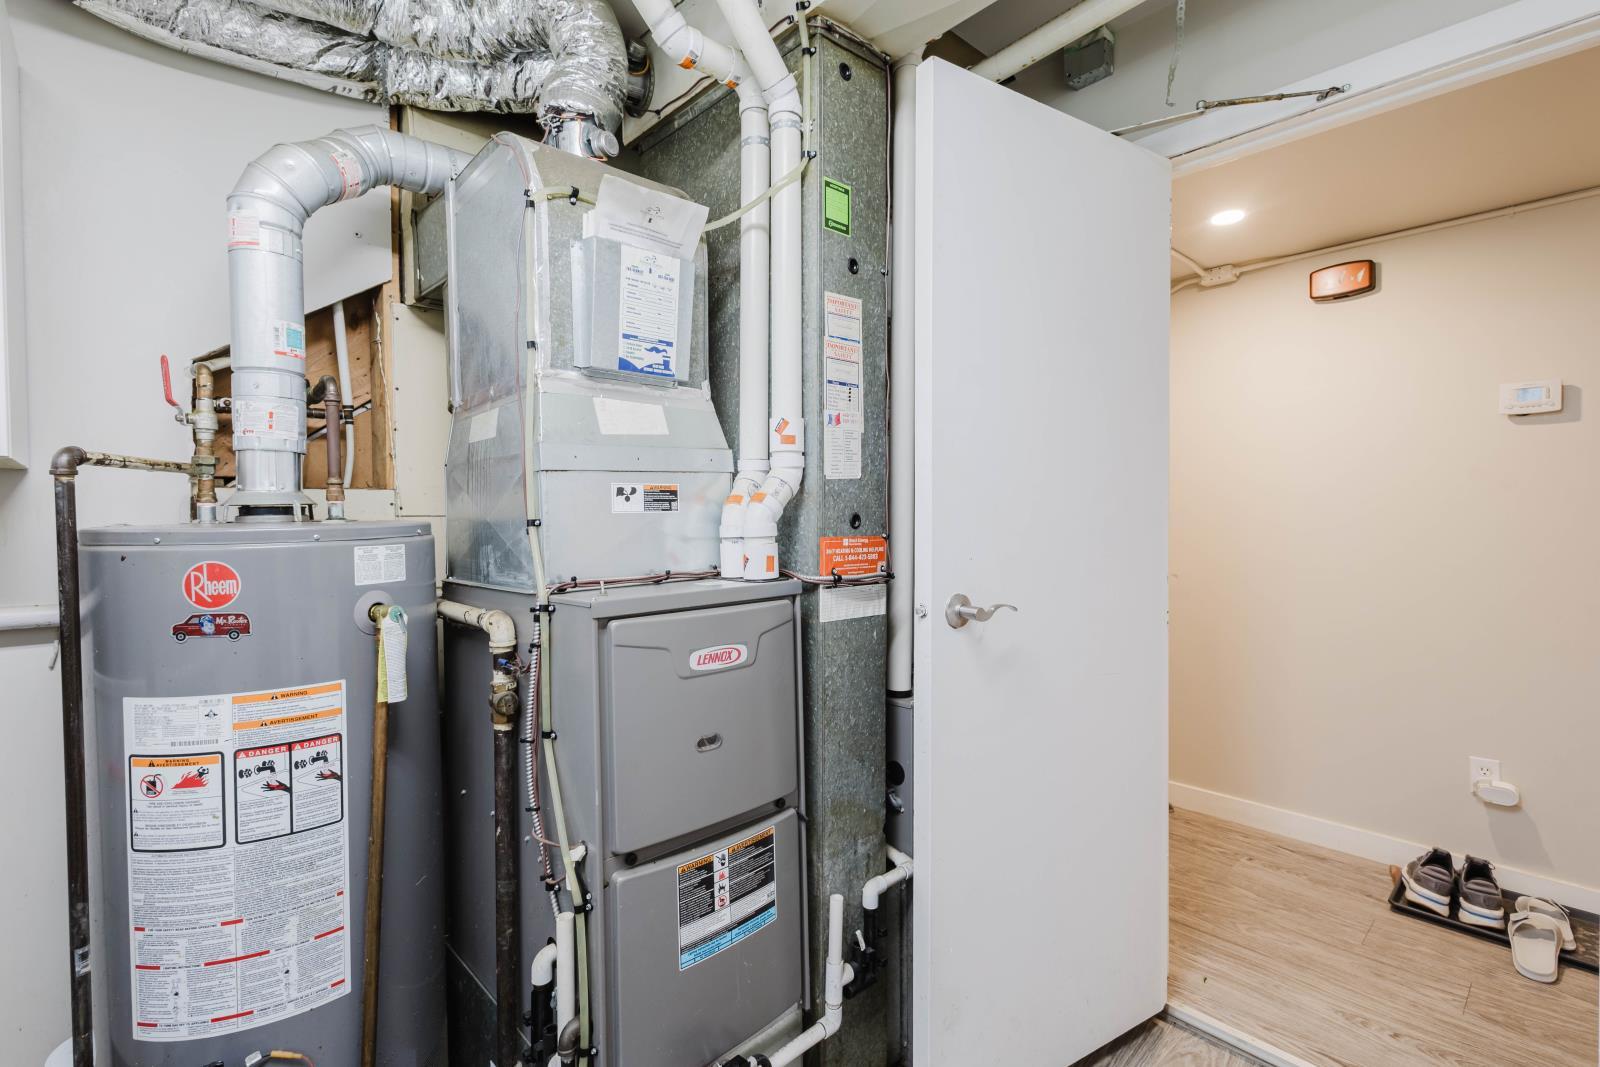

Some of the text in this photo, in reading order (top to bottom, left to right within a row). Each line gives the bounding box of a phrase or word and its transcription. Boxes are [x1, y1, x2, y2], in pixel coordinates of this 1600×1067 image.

[190, 563, 237, 602] Rheem
[697, 650, 733, 666] LENNOX
[280, 690, 308, 699] WARNING
[269, 713, 318, 726] AVERTISSEMENT
[303, 737, 339, 749] DANGER
[248, 746, 287, 757] DANGER
